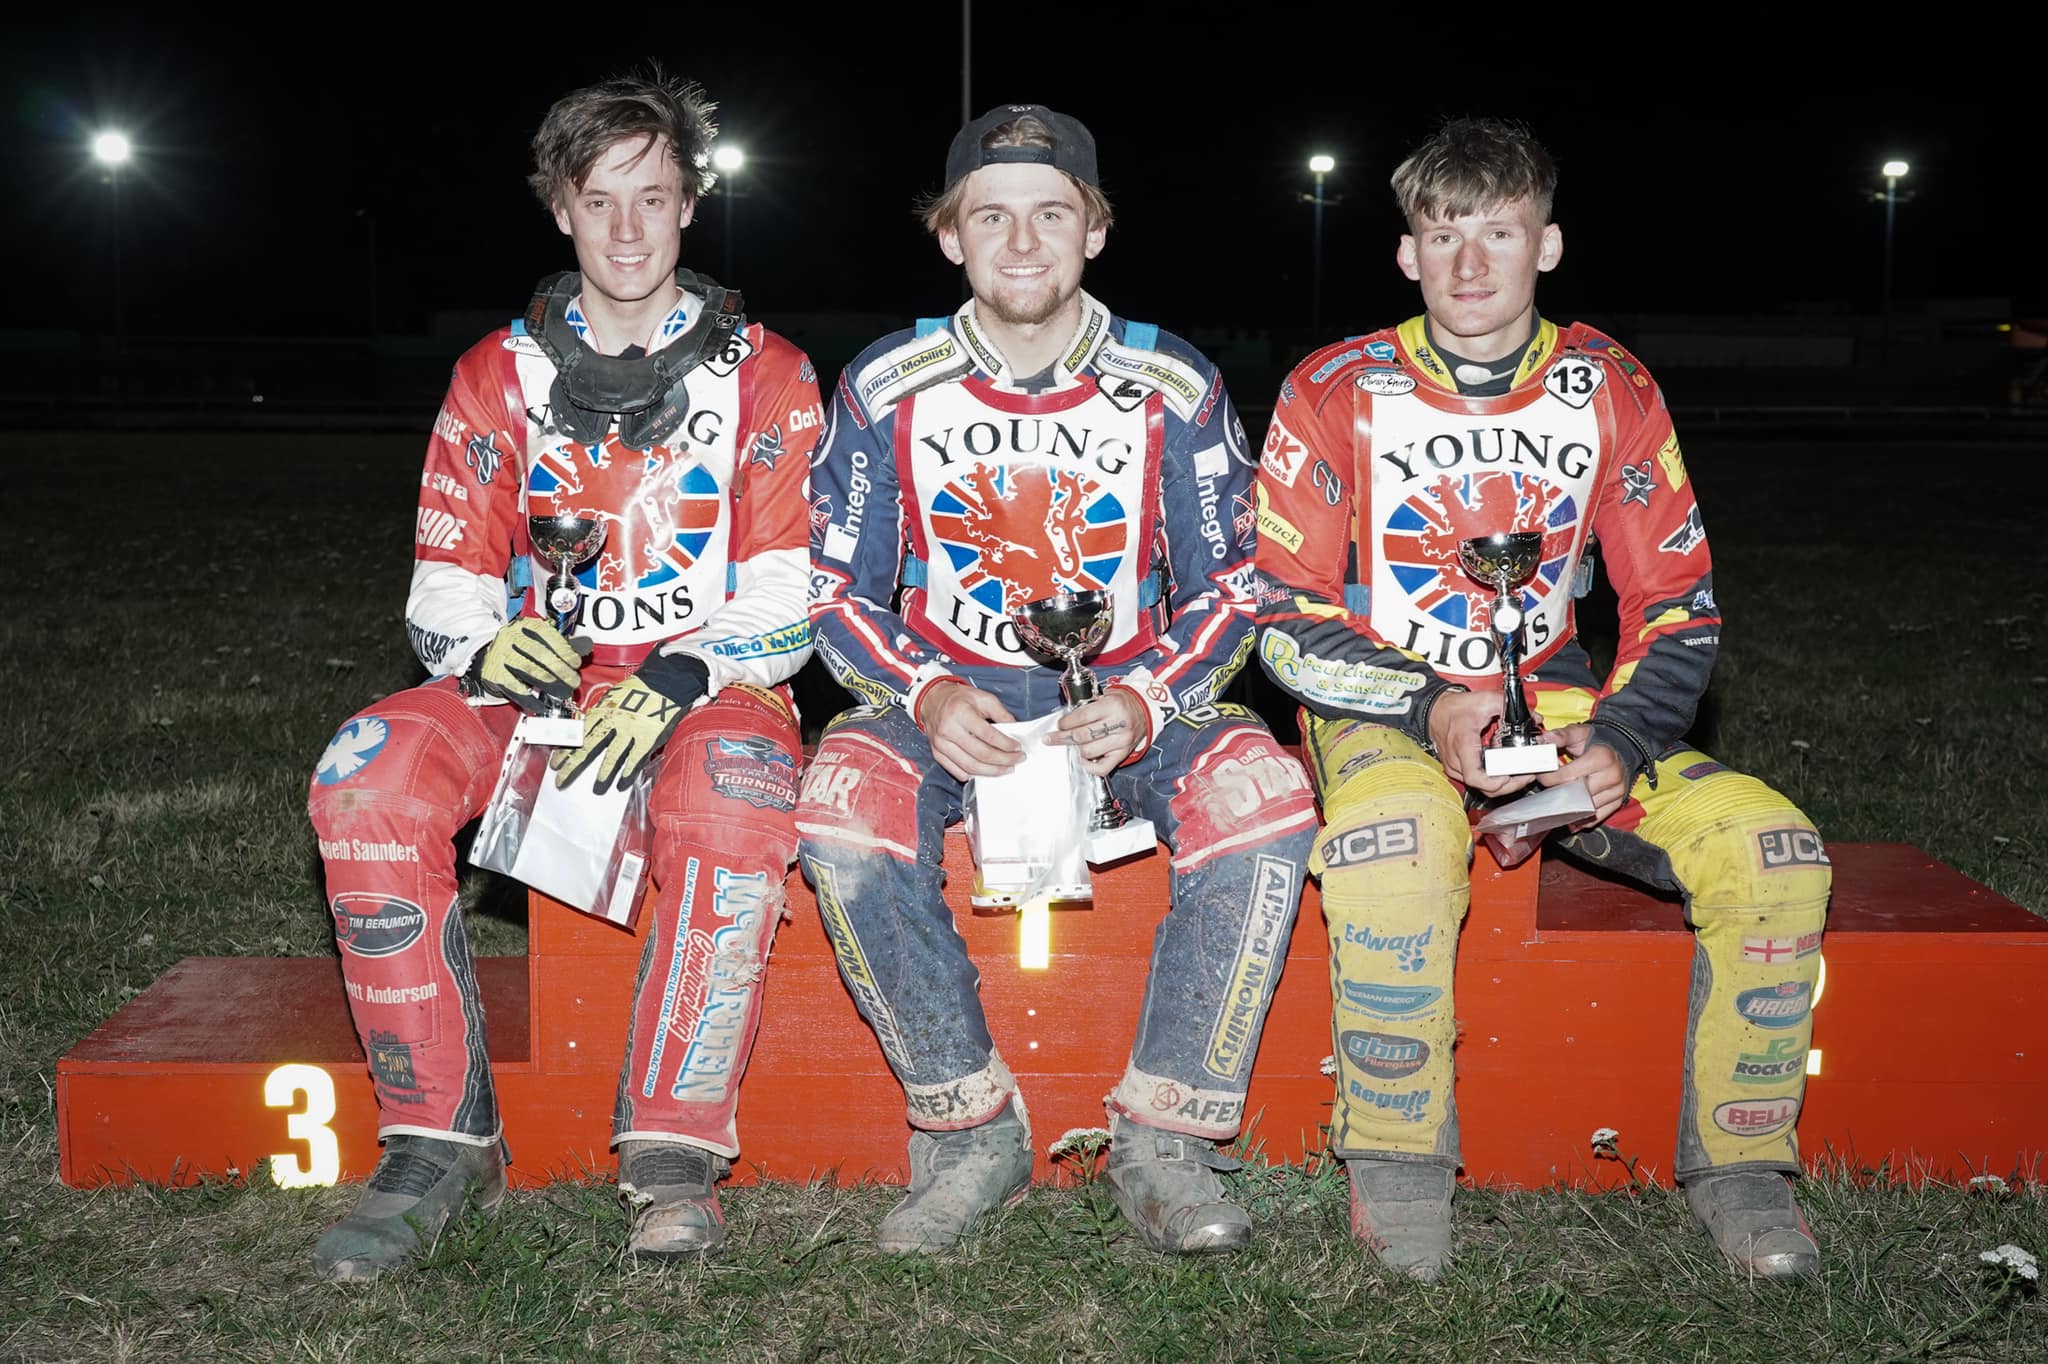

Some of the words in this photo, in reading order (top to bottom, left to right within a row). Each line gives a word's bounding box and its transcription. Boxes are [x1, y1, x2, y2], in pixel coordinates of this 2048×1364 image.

[865, 369, 899, 399] Allied
[901, 346, 952, 373] Mobility
[1103, 352, 1143, 370] Allied
[1144, 365, 1195, 399] Mobility
[1553, 366, 1593, 394] 13
[920, 419, 1132, 475] YOUNG
[1380, 428, 1593, 482] YOUNG
[838, 451, 871, 538] integro
[1198, 472, 1227, 559] integro
[575, 586, 694, 631] IONS
[949, 595, 1027, 653] LIO
[713, 640, 763, 656] Allied
[817, 638, 846, 676] Allied
[603, 687, 679, 722] FOX
[715, 773, 796, 804] TORNADO
[352, 838, 419, 862] Saunders
[1329, 822, 1415, 864] JCB
[688, 859, 698, 889] BULK
[349, 917, 363, 929] TIM
[365, 913, 422, 929] BEAUMONT
[677, 891, 693, 938] HAULAGE
[1253, 867, 1286, 959] Allied
[1345, 923, 1433, 951] Edward
[366, 982, 438, 1003] Anderson
[1213, 962, 1265, 1072] Mobility
[643, 1020, 667, 1096] CONTRACTORS
[1349, 1035, 1419, 1061] gbm
[1735, 1061, 1784, 1075] ROCK
[1350, 1080, 1431, 1109] Reggie
[264, 1063, 340, 1189] 3
[1728, 1105, 1791, 1126] BELL
